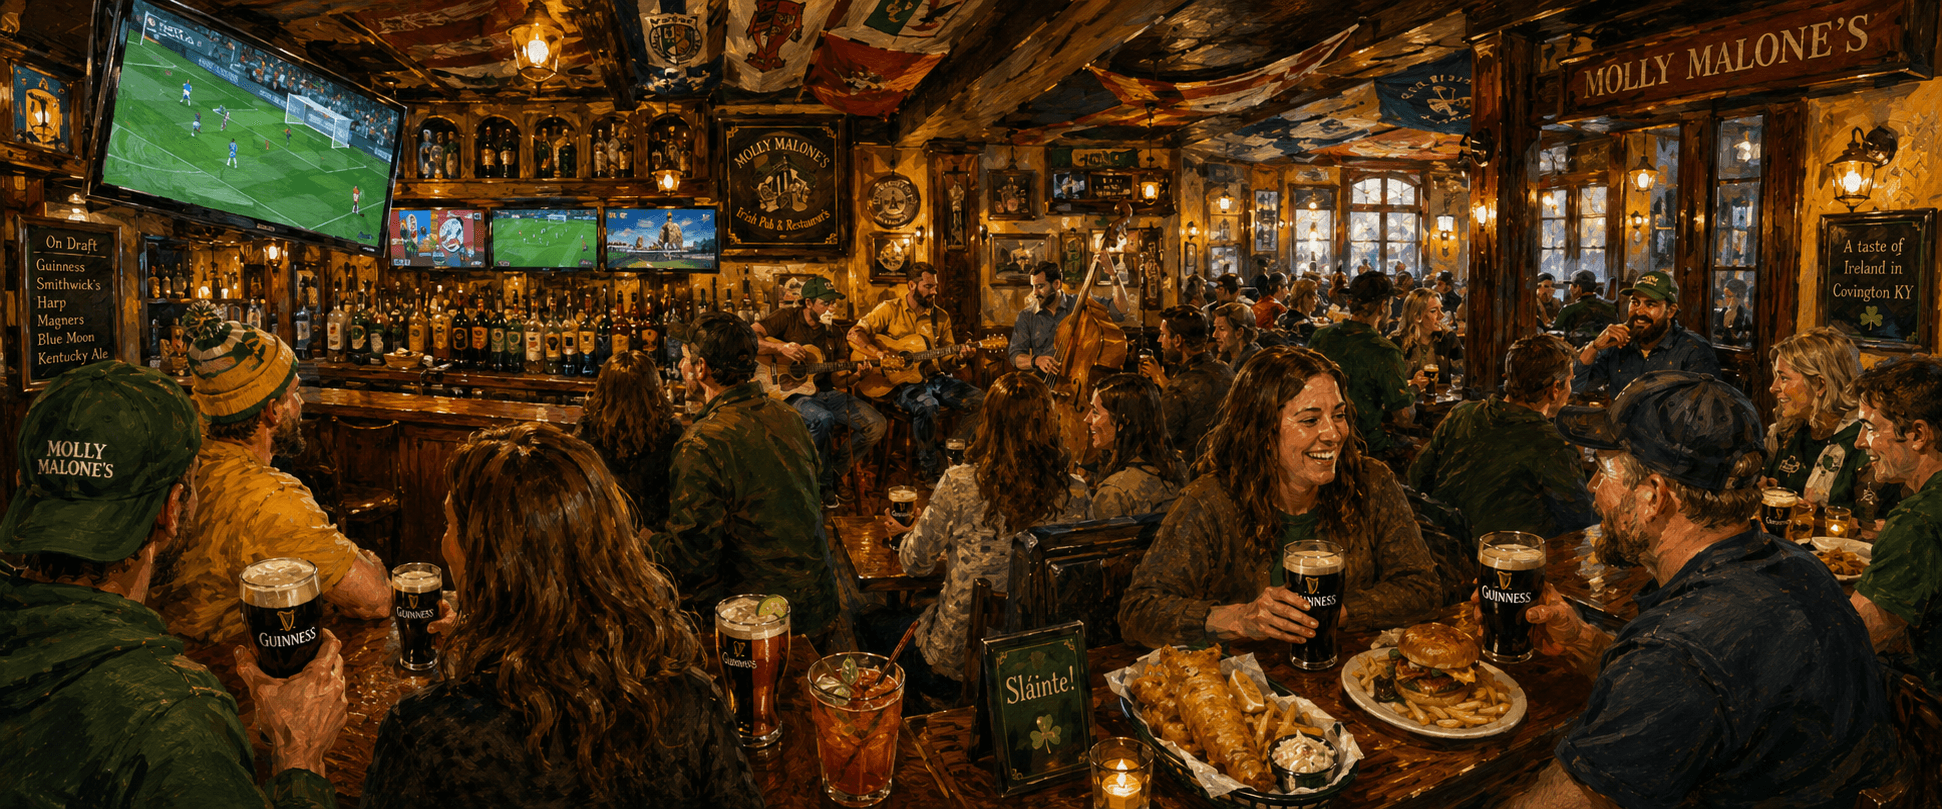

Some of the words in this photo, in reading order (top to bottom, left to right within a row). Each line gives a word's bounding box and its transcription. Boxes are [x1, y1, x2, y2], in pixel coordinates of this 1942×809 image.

[1583, 53, 1674, 98] MOLLY
[1686, 14, 1869, 80] MALONE'S
[734, 138, 771, 169] MOLLY
[774, 137, 830, 168] MALONE'S
[736, 206, 757, 225] Irish
[759, 216, 774, 230] Pub
[776, 219, 783, 231] &
[45, 234, 62, 249] On
[66, 236, 98, 254] Draft
[1843, 239, 1853, 253] A
[1857, 240, 1887, 253] taste
[1891, 237, 1905, 257] of
[36, 258, 85, 272] Guinness
[1844, 260, 1886, 275] Ireland
[1890, 261, 1903, 275] in
[36, 277, 101, 291] Smithwick's
[1833, 282, 1890, 303] Covington
[1894, 284, 1914, 300] KY
[37, 295, 67, 312] Harp
[37, 314, 84, 330] Magners
[37, 332, 63, 346] Blue
[66, 331, 95, 344] Moon
[38, 349, 88, 366] Kentucky
[91, 347, 109, 360] Ale
[46, 440, 107, 460] MOLLY
[37, 458, 114, 479] MALONE'S
[1303, 594, 1337, 607] NNESS
[1481, 584, 1532, 604] GUINNESS
[396, 606, 434, 619] GUINNESS
[258, 626, 317, 648] GUINNESS
[1005, 665, 1076, 705] Sláinte!
